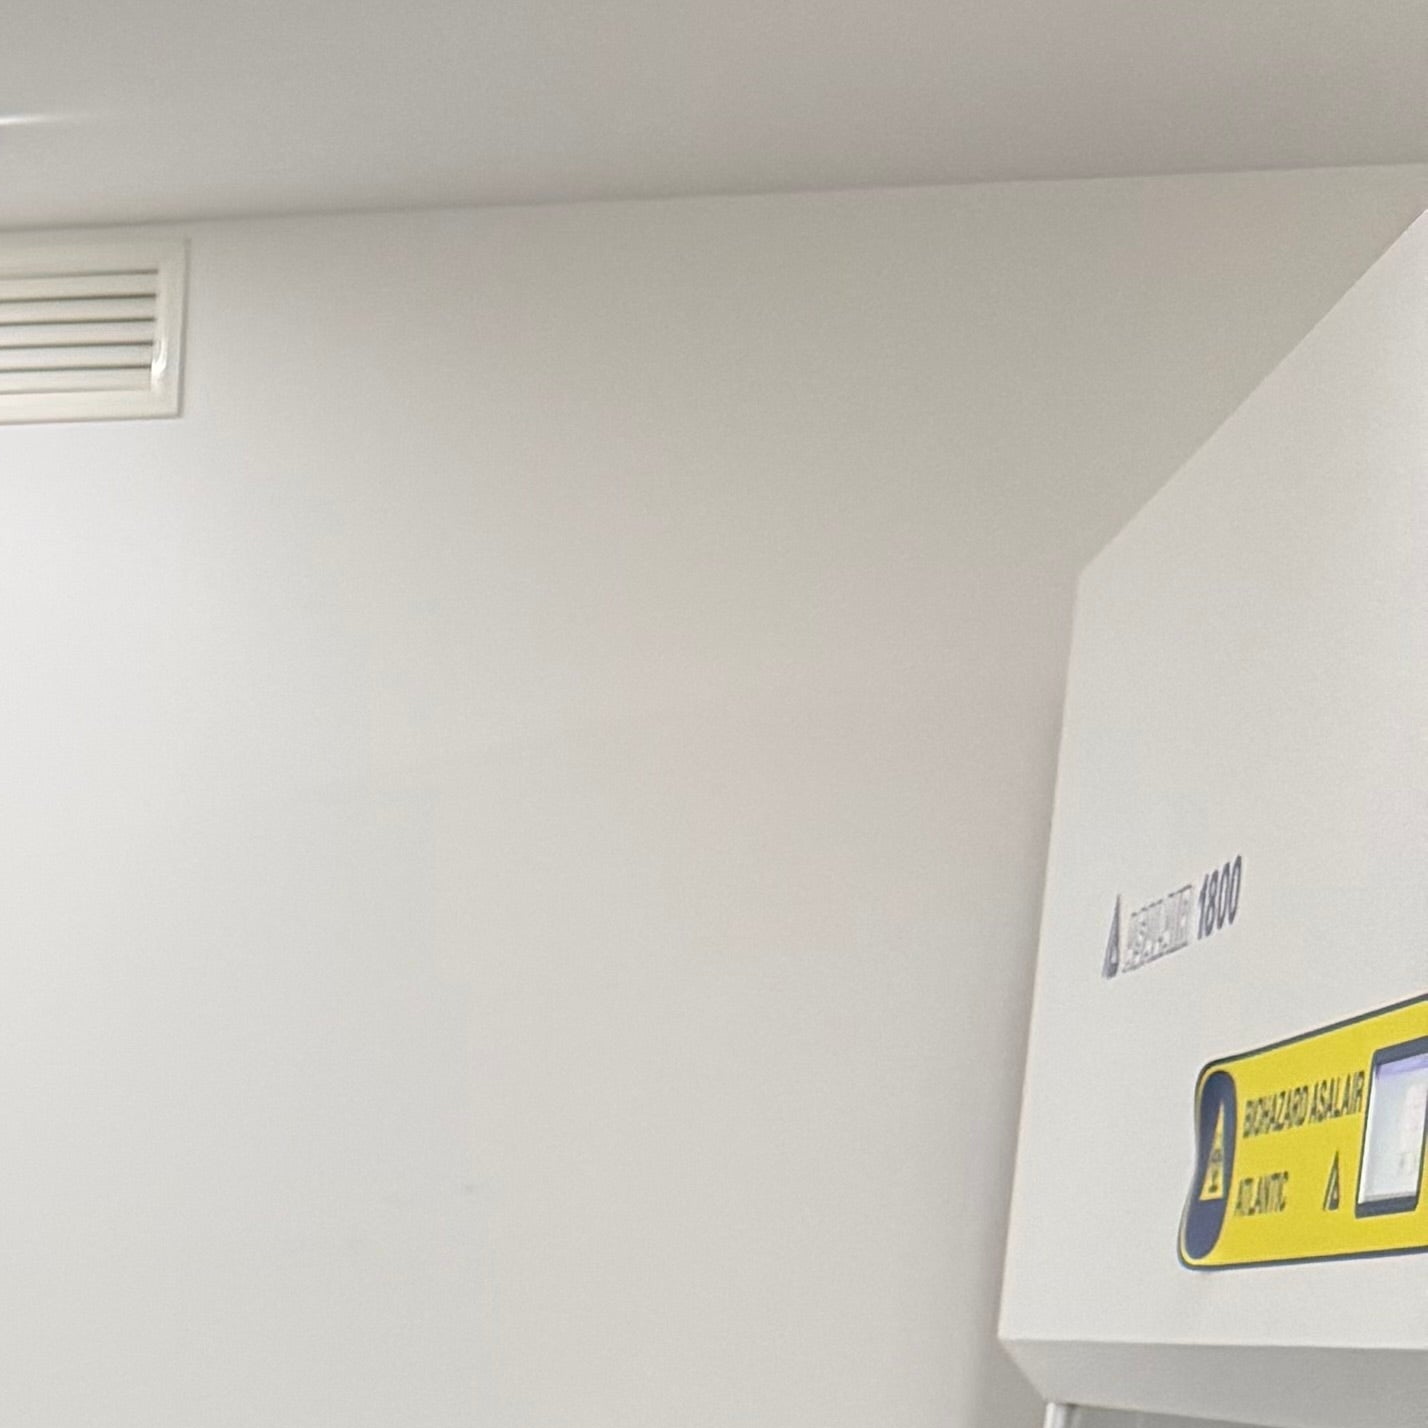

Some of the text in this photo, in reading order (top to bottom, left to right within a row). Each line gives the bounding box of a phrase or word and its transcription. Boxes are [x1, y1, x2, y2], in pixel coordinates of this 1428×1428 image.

[1197, 854, 1242, 940] 1800
[1242, 1083, 1309, 1139] BIOHAZARD
[1233, 1170, 1289, 1217] ATLANTIC
